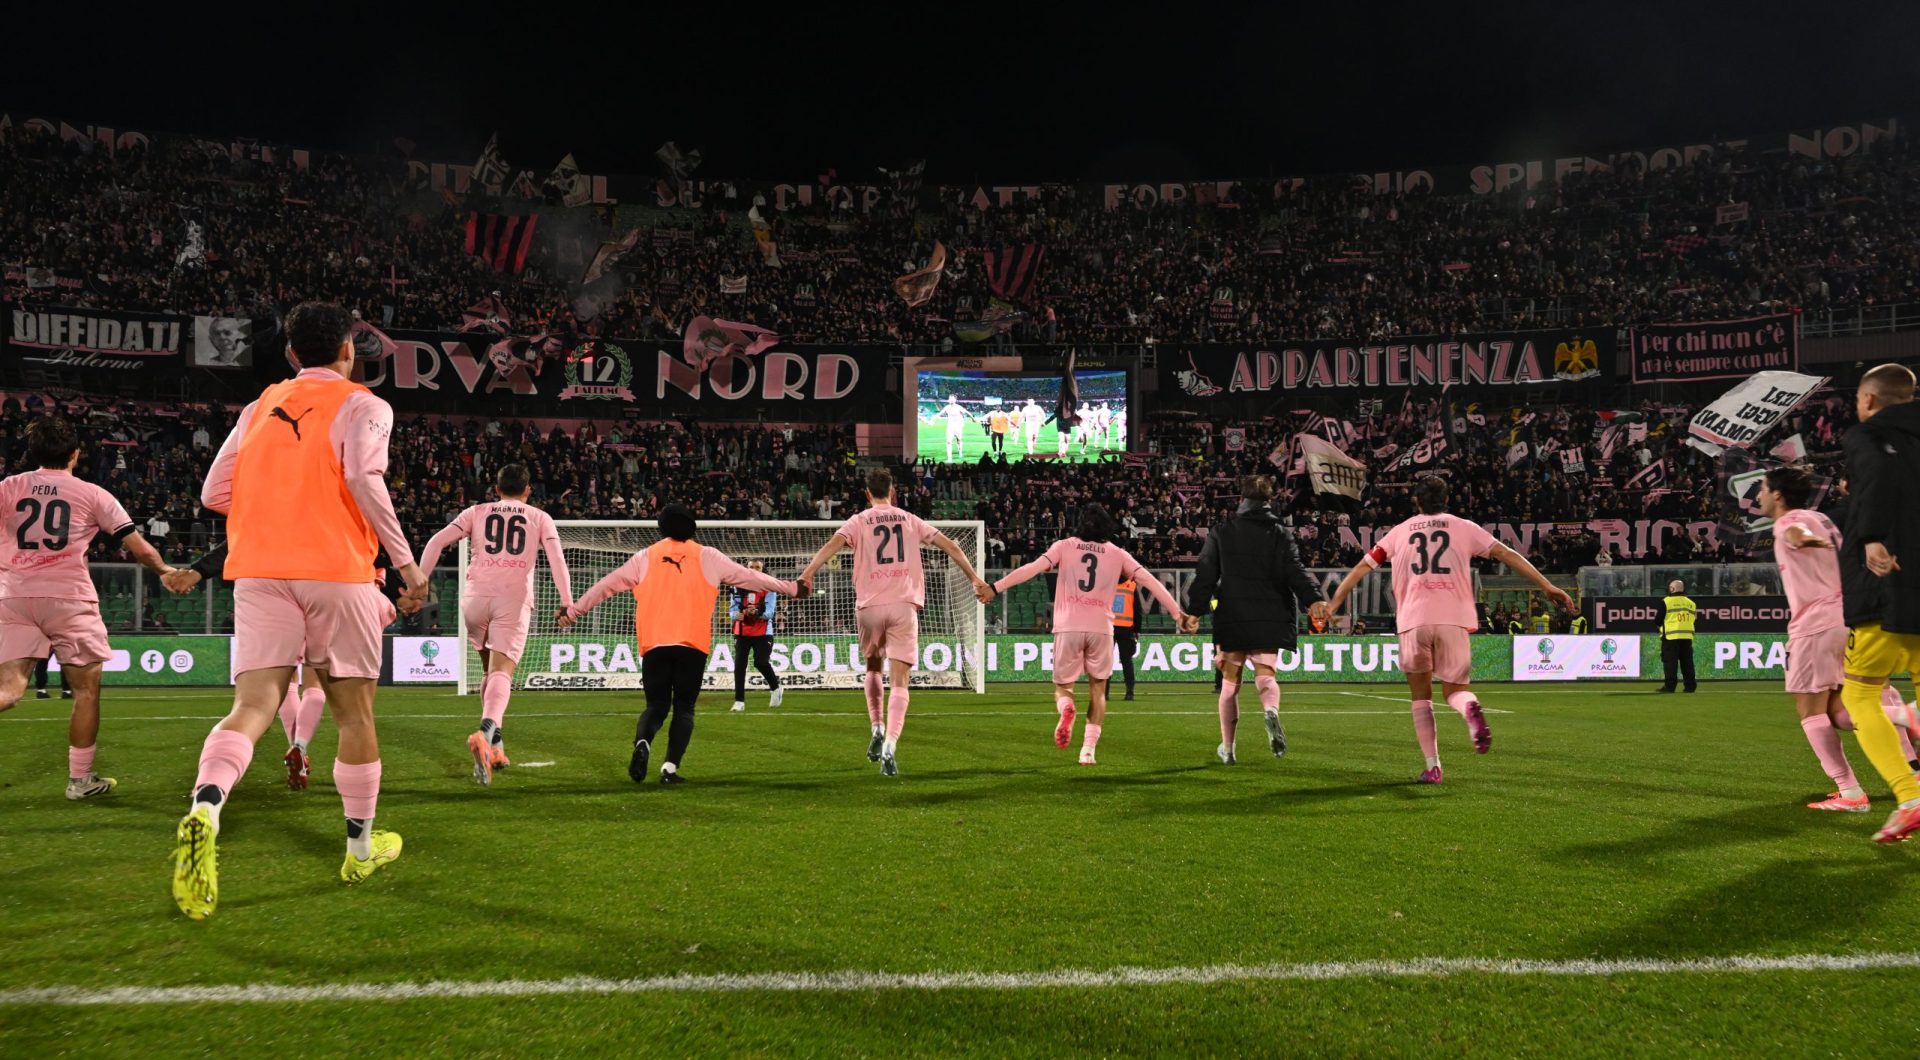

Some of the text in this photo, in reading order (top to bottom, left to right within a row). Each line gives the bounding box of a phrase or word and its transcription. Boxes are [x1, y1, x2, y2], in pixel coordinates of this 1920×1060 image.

[1788, 118, 1897, 160] NON
[12, 309, 181, 352] DIFFIDATI
[1675, 329, 1707, 352] chi
[1711, 330, 1750, 351] non
[38, 349, 144, 370] Palermo
[350, 339, 860, 400] URVA NORD
[579, 355, 615, 384] 12
[1228, 340, 1544, 393] APPARTENENZA
[1674, 356, 1730, 375] sempre
[1733, 352, 1761, 370] con
[1764, 347, 1788, 368] noi
[32, 485, 58, 496] PEDA
[16, 498, 71, 550] 29
[491, 506, 525, 515] MAGNANI
[1409, 520, 1449, 531] CECCARONI
[485, 514, 527, 556] 96
[873, 524, 905, 565] 21
[1076, 543, 1106, 554] AUGELLO
[1409, 530, 1451, 575] 32
[1078, 553, 1098, 592] 3
[410, 667, 450, 675] PRAGMA
[551, 643, 735, 673] PRAA
[769, 642, 998, 672] SOLUONI
[528, 675, 606, 688] GoldBet
